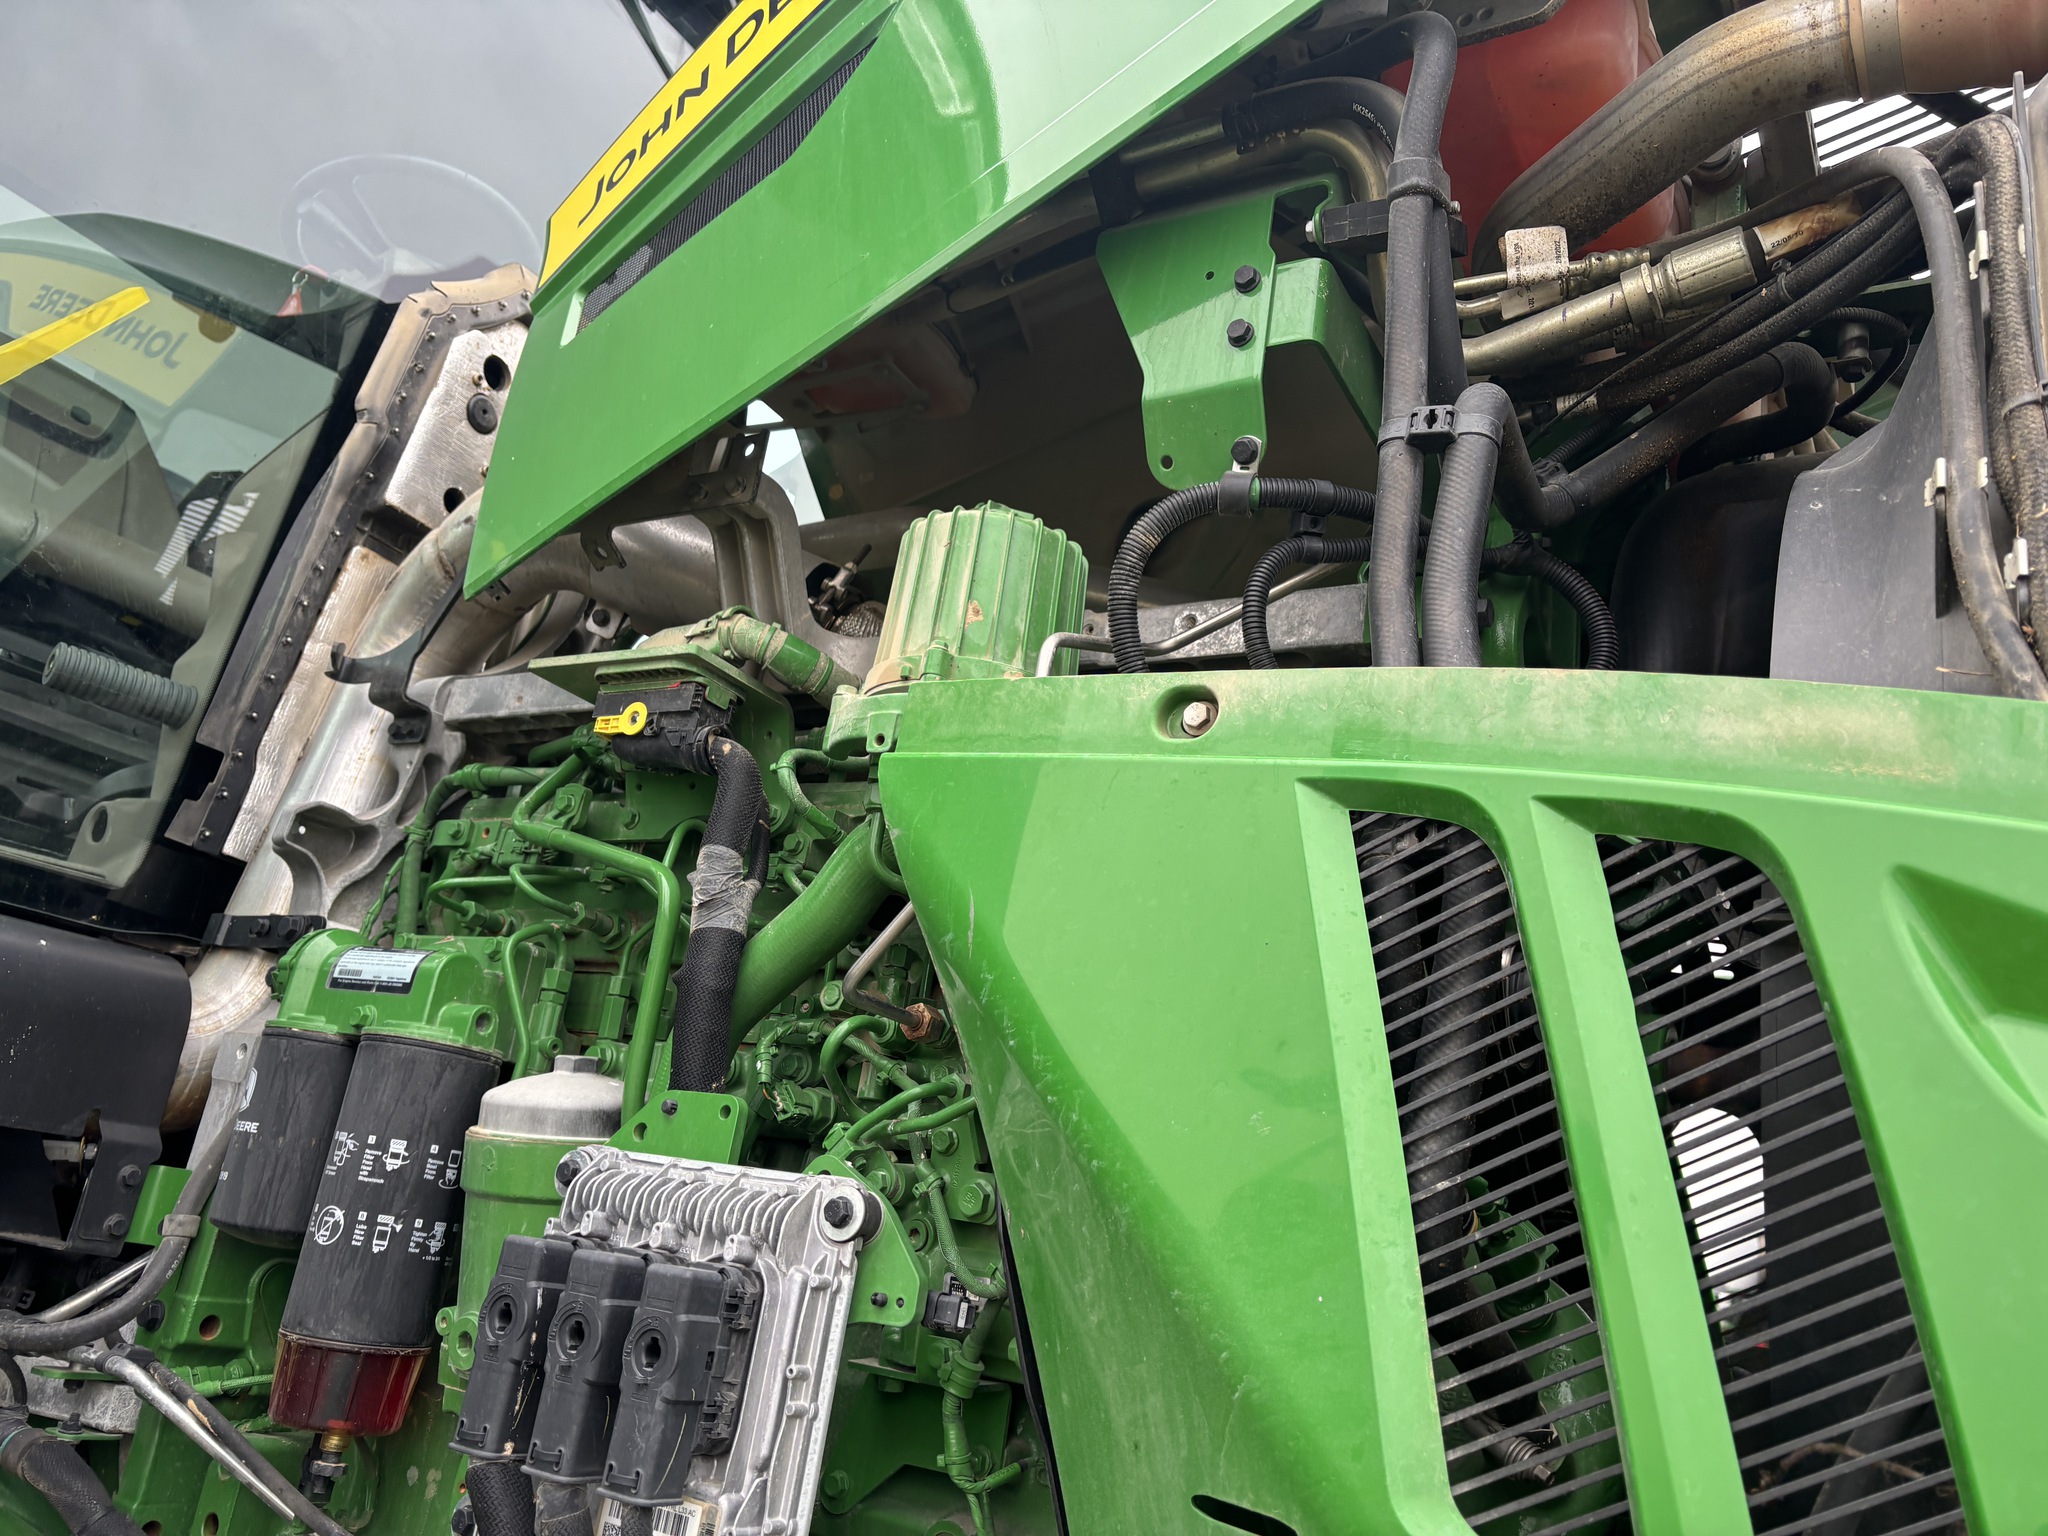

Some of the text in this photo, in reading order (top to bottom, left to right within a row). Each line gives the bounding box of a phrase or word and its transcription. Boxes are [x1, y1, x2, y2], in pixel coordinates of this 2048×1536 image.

[577, 64, 709, 228] JOHN
[235, 1120, 259, 1133] EERE
[678, 1506, 687, 1515] L33
[687, 1509, 696, 1517] AC
